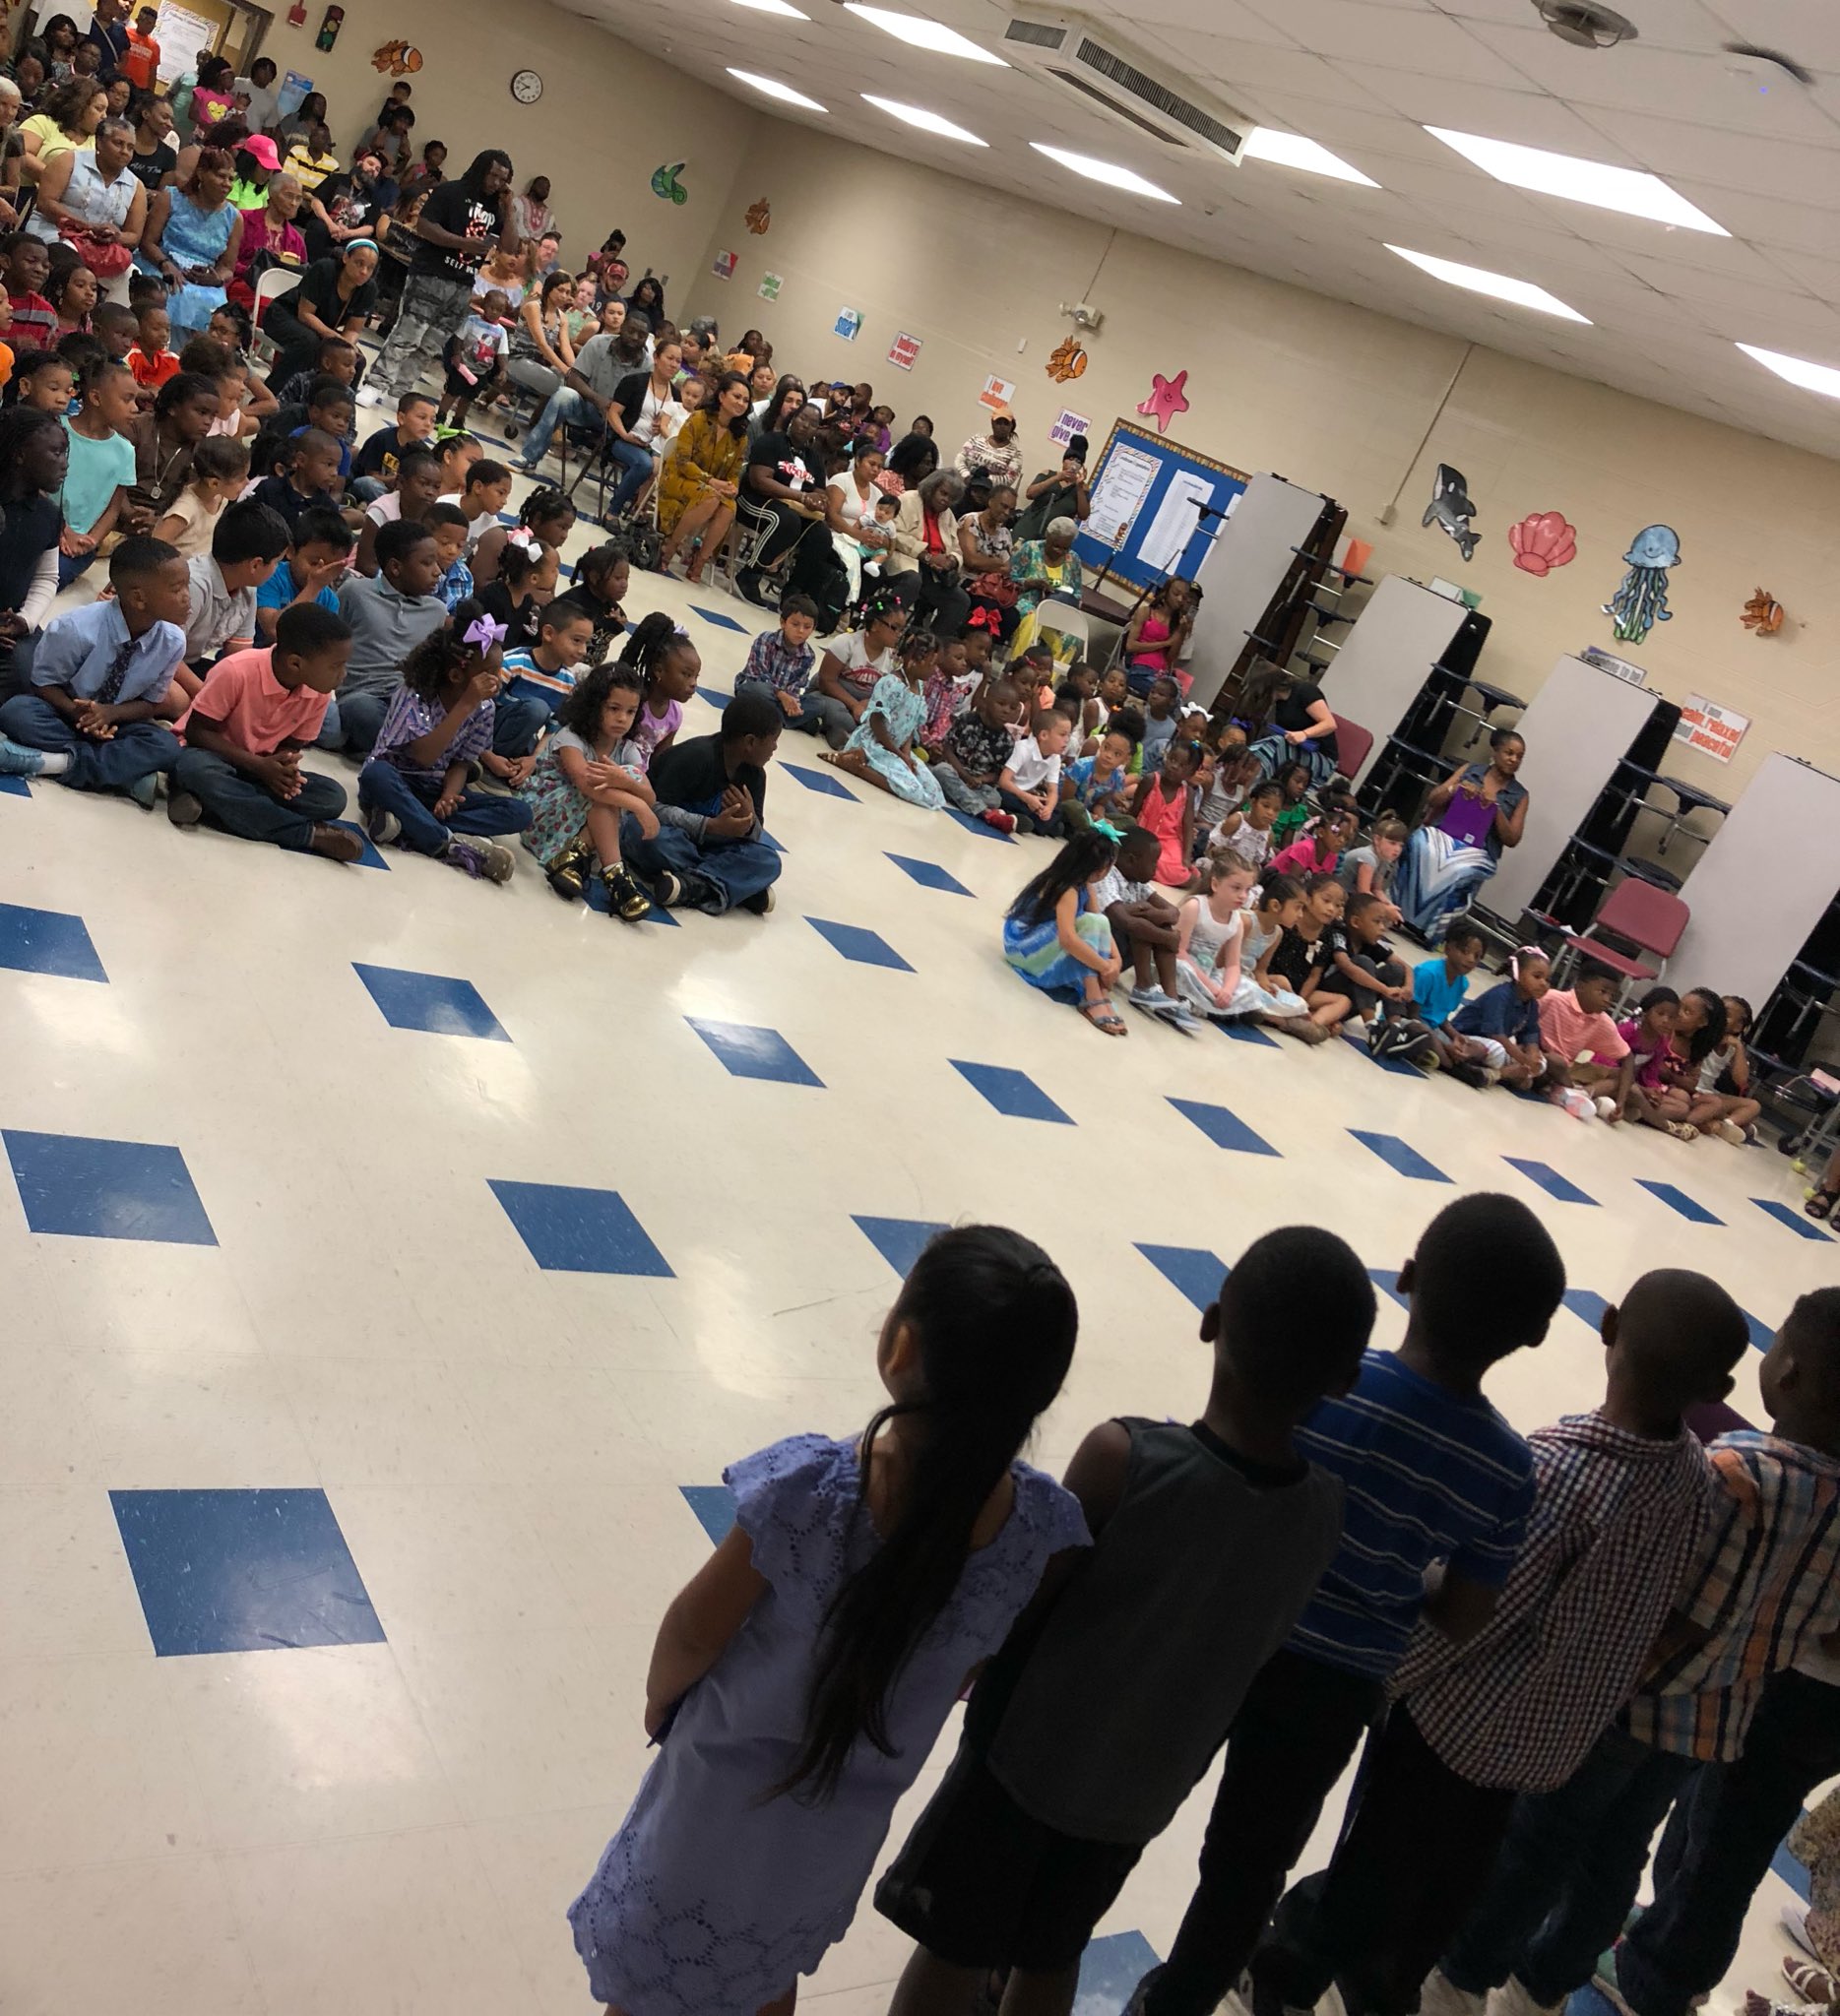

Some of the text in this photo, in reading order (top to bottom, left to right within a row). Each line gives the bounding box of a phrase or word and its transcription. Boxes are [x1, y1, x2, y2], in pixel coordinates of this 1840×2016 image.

[1050, 424, 1071, 442] give
[1061, 413, 1089, 433] never
[1705, 716, 1743, 744] relaxed
[1688, 728, 1735, 759] peaceful
